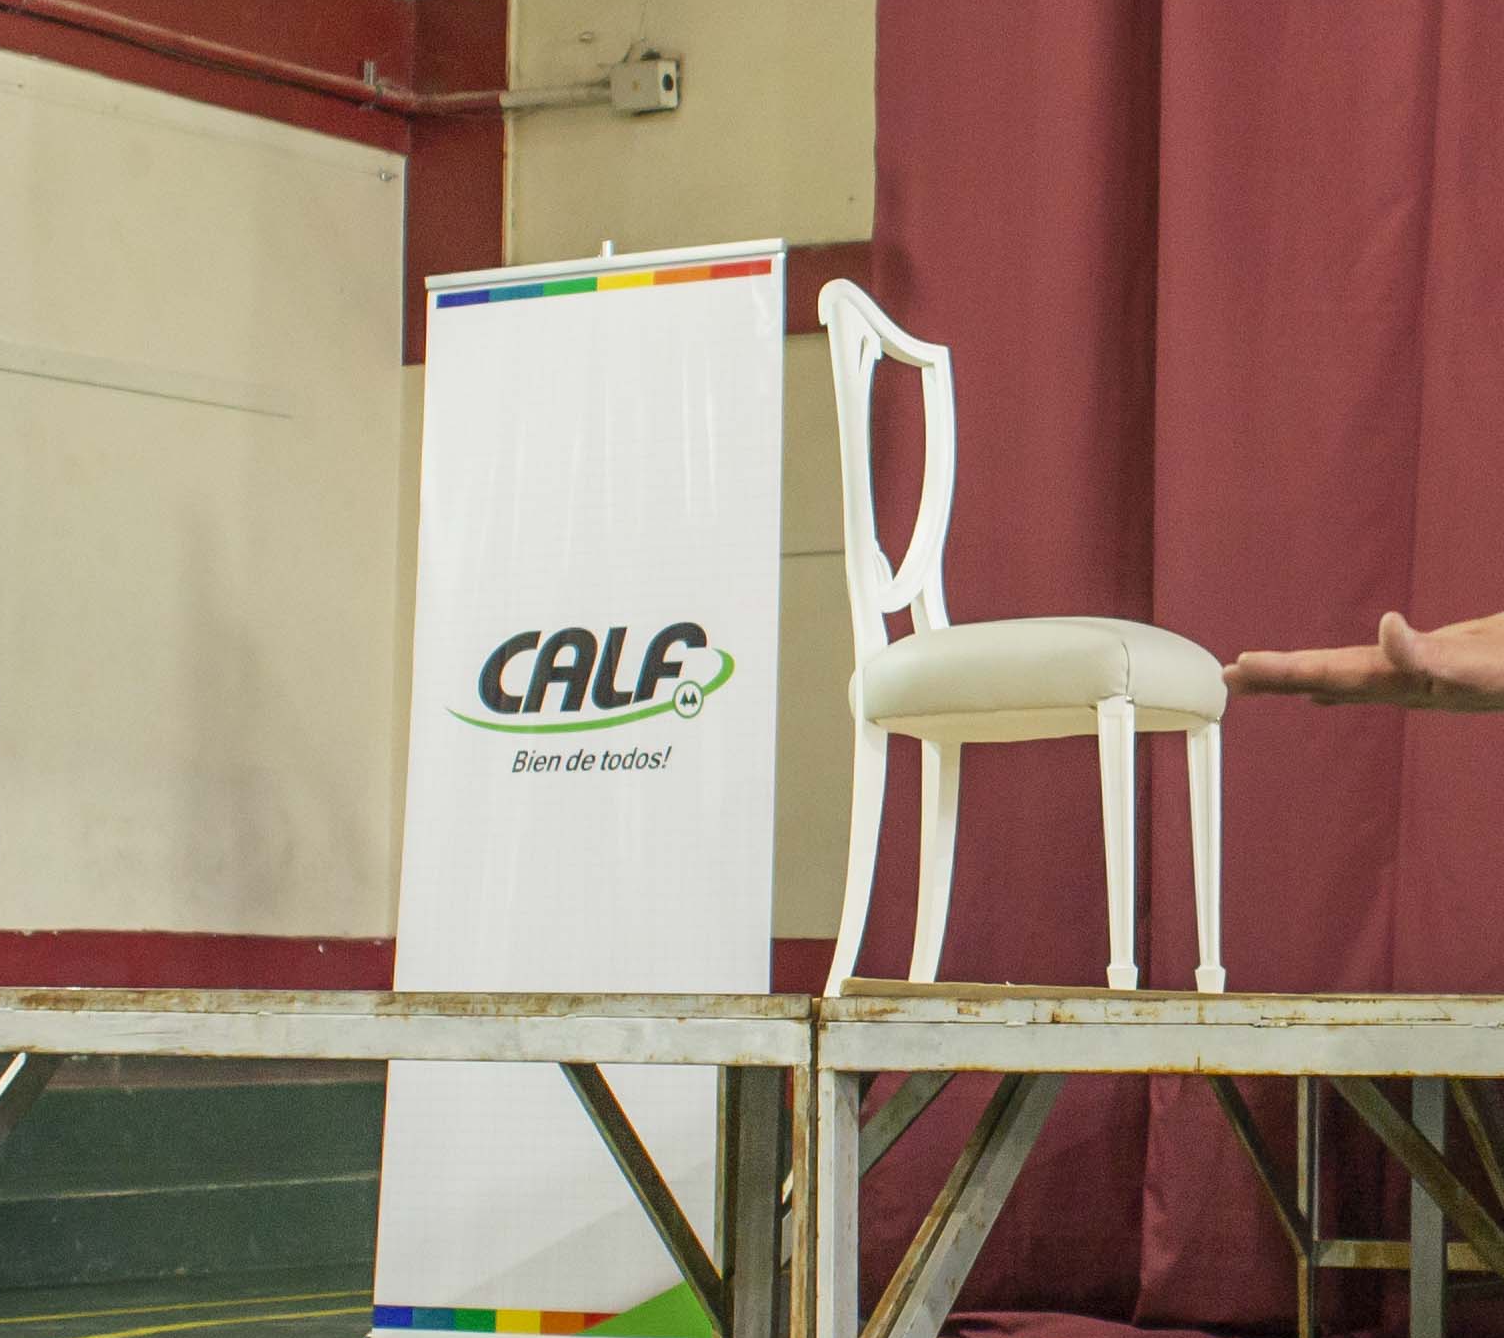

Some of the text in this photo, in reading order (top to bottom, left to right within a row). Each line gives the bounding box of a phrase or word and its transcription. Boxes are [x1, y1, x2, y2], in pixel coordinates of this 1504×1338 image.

[477, 621, 708, 715] CALF
[511, 745, 673, 773] Bien de todos!
